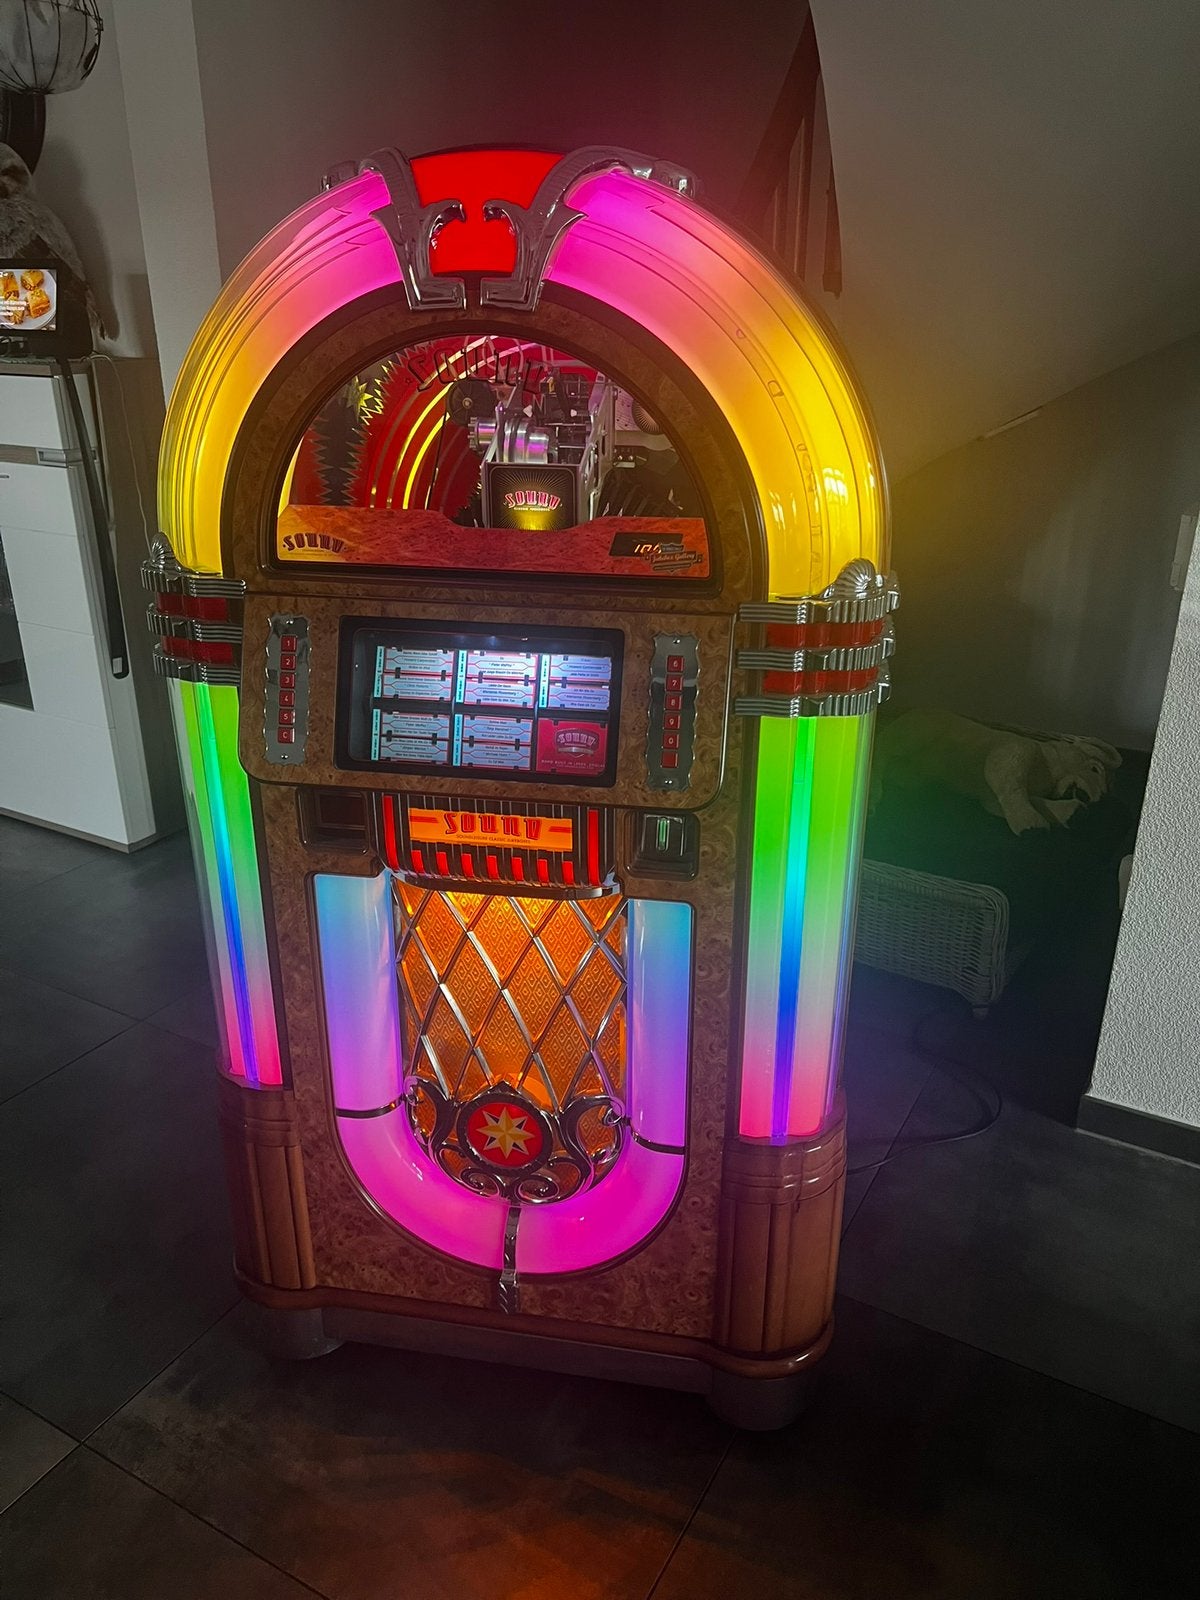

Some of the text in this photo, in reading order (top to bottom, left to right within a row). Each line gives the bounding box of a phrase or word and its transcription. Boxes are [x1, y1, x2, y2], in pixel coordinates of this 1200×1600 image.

[504, 490, 561, 511] SOUND
[283, 532, 344, 553] SOUND
[443, 812, 542, 841] SOUND
